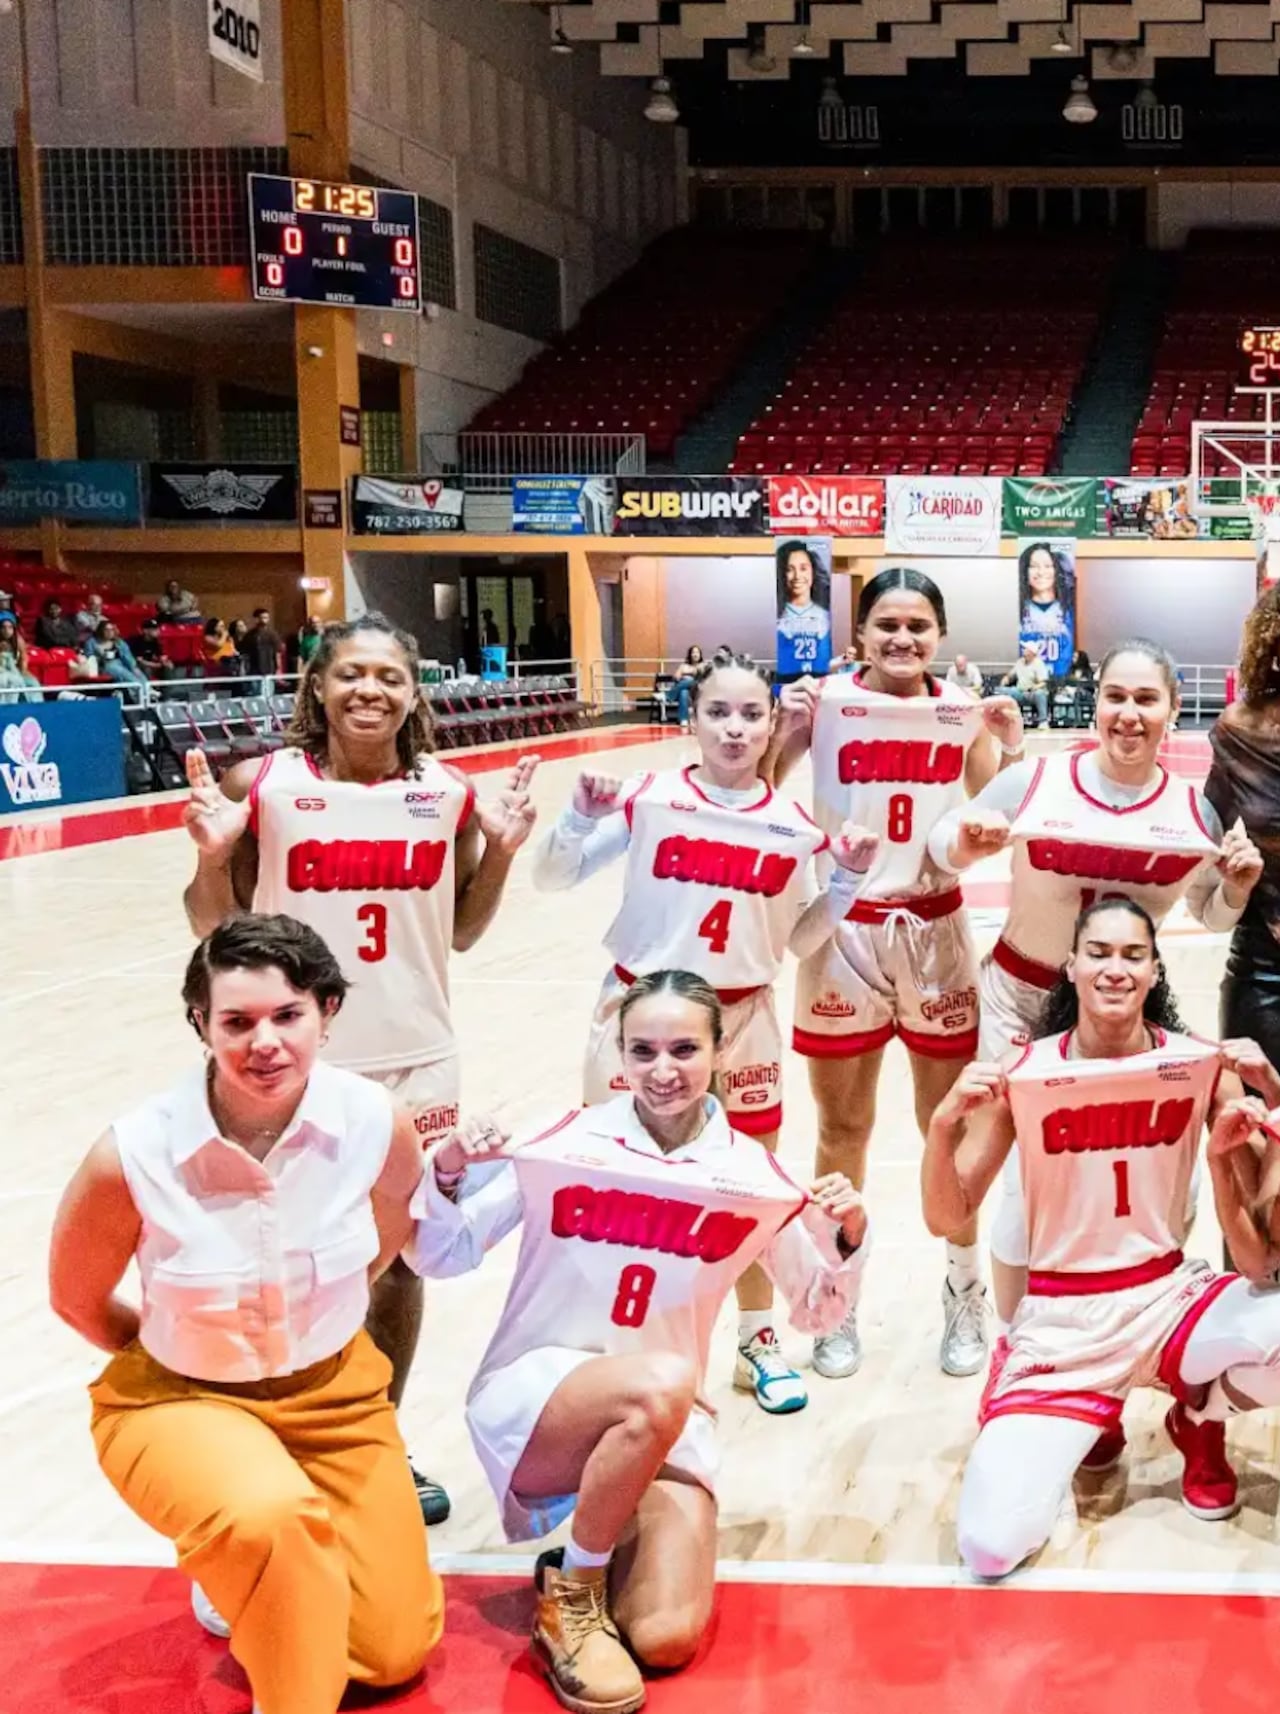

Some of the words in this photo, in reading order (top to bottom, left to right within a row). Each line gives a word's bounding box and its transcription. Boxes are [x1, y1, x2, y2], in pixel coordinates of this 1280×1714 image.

[213, 0, 260, 59] 2010
[296, 182, 375, 217] 21:25
[260, 210, 298, 225] HOME
[321, 222, 352, 235] PERIOD
[371, 222, 410, 237] GUEST
[283, 227, 303, 255] 0
[337, 236, 346, 257] 1
[395, 239, 413, 266] 0
[266, 263, 283, 286] 0
[311, 257, 344, 270] PLAYER
[400, 276, 415, 298] 0
[65, 482, 126, 509] Rico
[617, 491, 761, 518] SUBWAY
[921, 496, 984, 520] CARIDAD
[1015, 506, 1041, 518] TWO
[1046, 505, 1087, 518] AMIGAS
[794, 638, 818, 660] 23
[887, 793, 914, 843] 8
[357, 903, 387, 964] 3
[698, 899, 734, 954] 4
[942, 1014, 968, 1029] 63
[741, 1089, 769, 1105] 63
[1112, 1160, 1132, 1218] 1
[610, 1263, 657, 1329] 8
